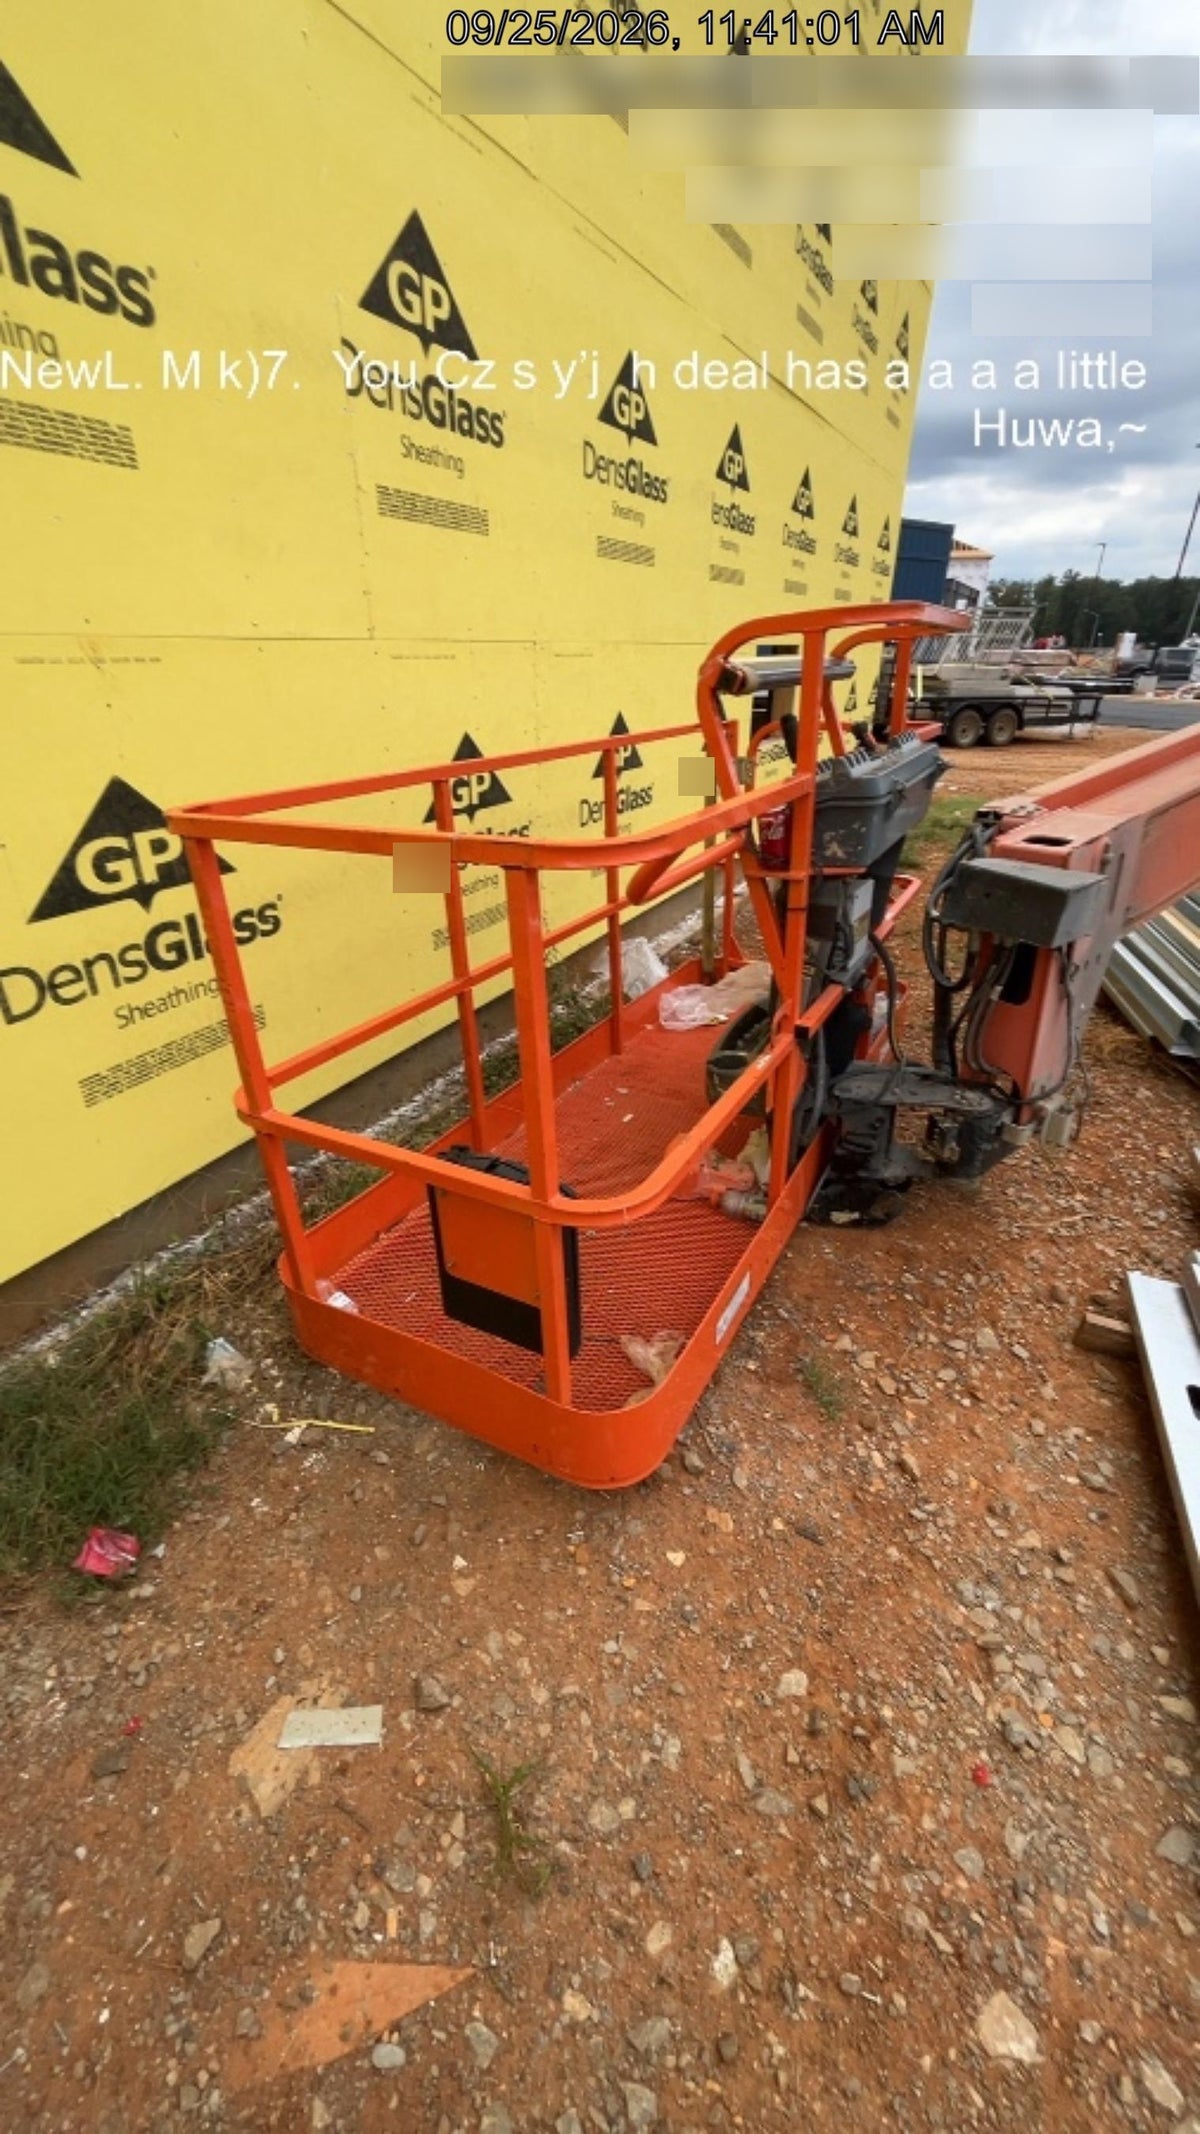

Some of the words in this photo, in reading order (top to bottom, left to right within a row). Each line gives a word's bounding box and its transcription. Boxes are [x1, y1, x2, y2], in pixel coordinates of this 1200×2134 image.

[0, 193, 156, 328] lass
[387, 259, 450, 333] GP
[341, 336, 504, 448] DensGlass
[613, 384, 645, 430] GP
[400, 434, 465, 479] Sheathing
[583, 438, 668, 503] DensGlass
[723, 449, 743, 483] GP
[711, 498, 756, 536] ensGlass
[450, 770, 491, 810] GP
[579, 786, 653, 827] DenGlass
[74, 827, 184, 895] GP
[0, 901, 282, 1026] DensGlss
[114, 975, 222, 1030] Sheathing
